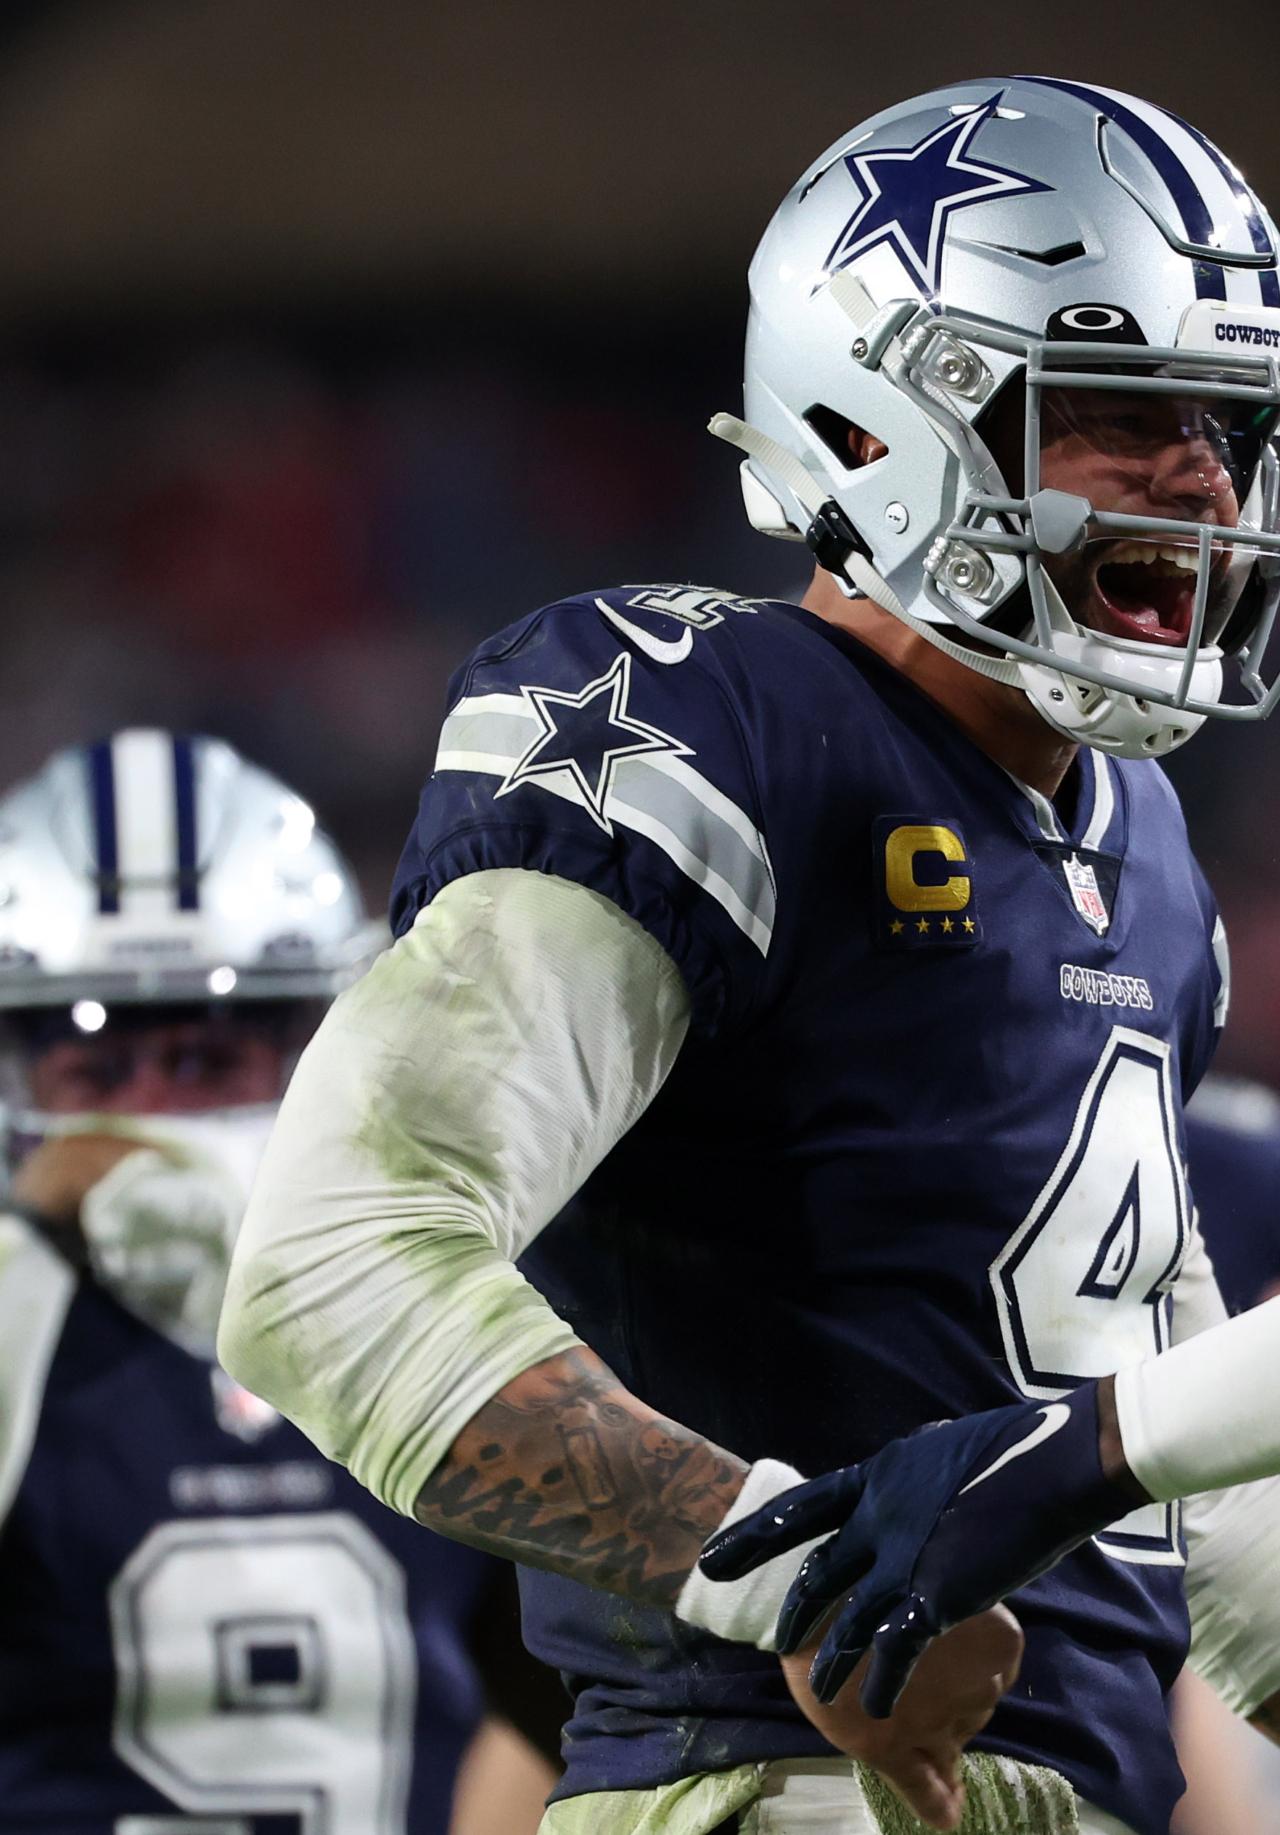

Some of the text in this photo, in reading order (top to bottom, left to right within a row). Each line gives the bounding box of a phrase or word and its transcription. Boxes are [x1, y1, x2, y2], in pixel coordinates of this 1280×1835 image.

[884, 824, 971, 912] C
[1060, 963, 1153, 1011] COWBOYS
[988, 1024, 1193, 1567] 4
[108, 1510, 418, 1835] 9
